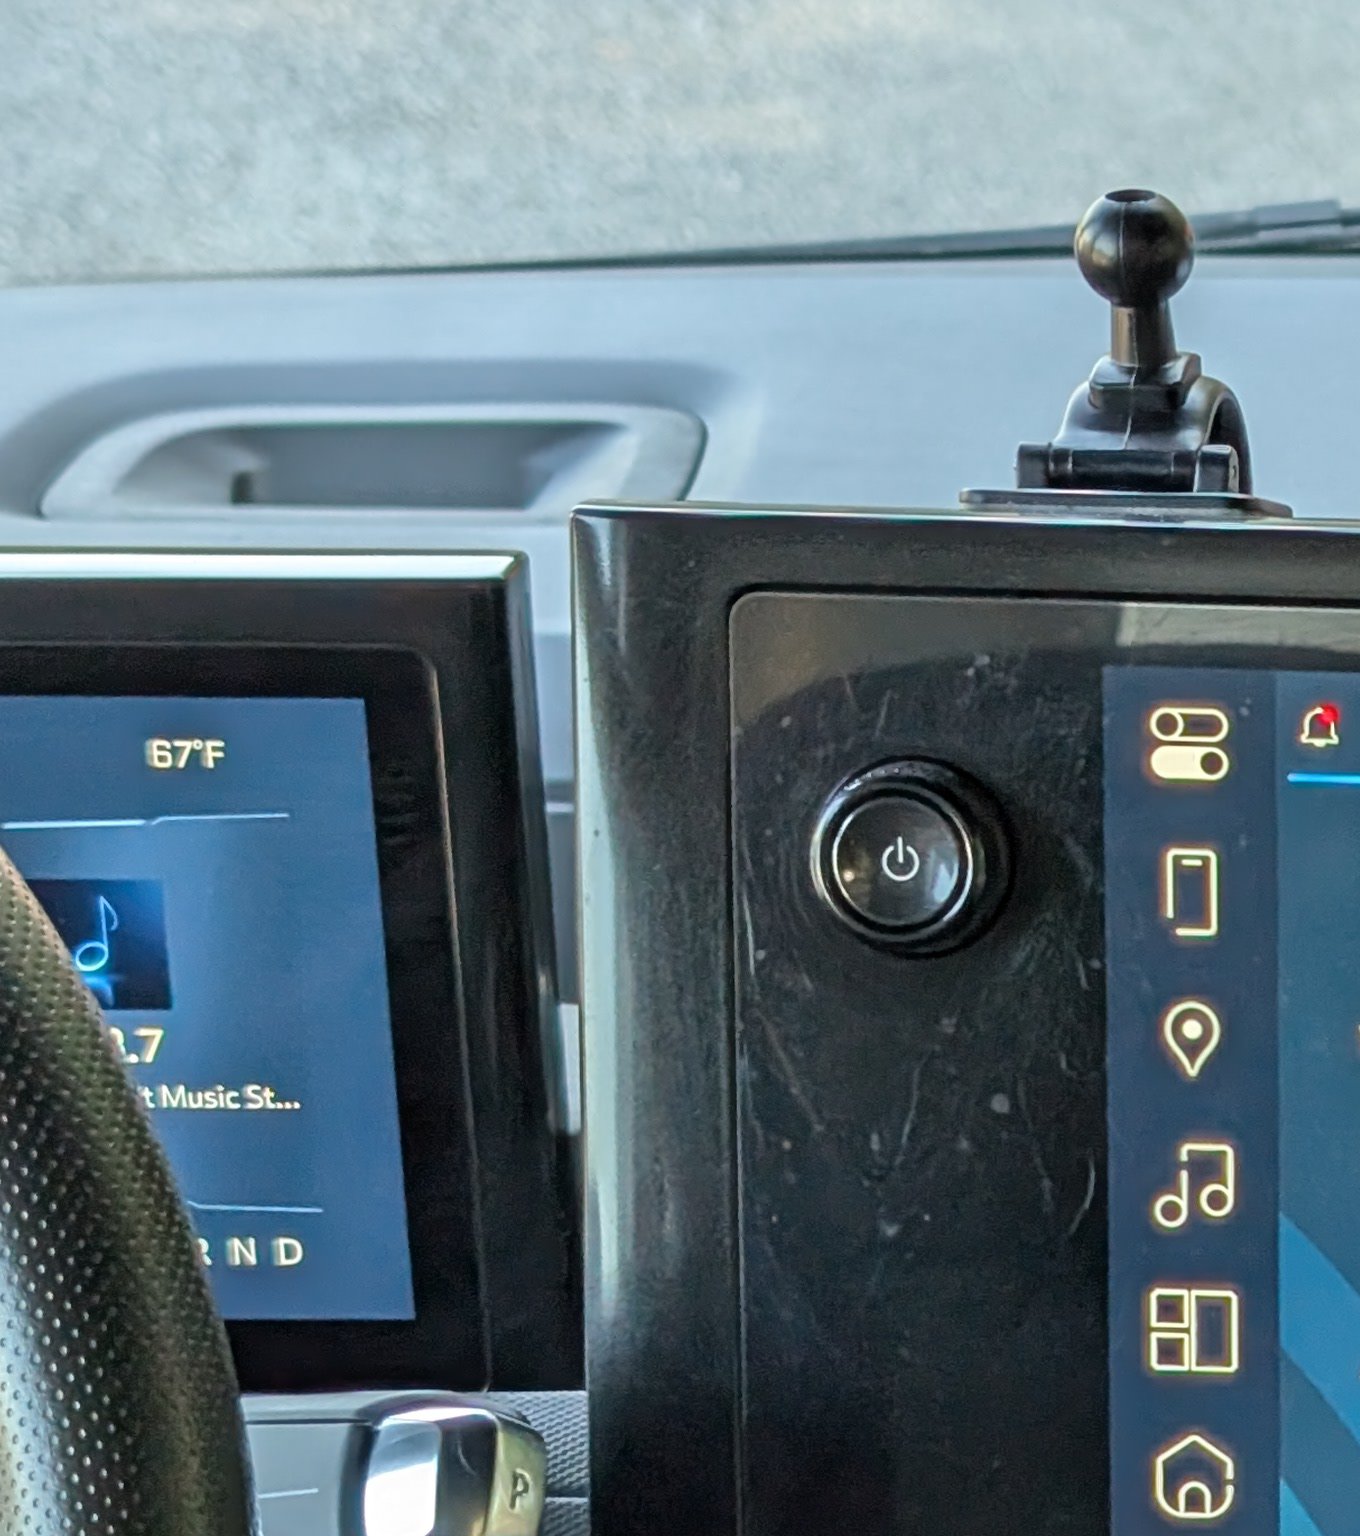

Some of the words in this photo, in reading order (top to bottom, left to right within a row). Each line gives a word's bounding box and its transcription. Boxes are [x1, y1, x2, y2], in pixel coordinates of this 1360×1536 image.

[145, 738, 226, 770] 67°F
[160, 1084, 240, 1110] Music
[228, 1237, 258, 1266] N
[274, 1236, 304, 1267] D
